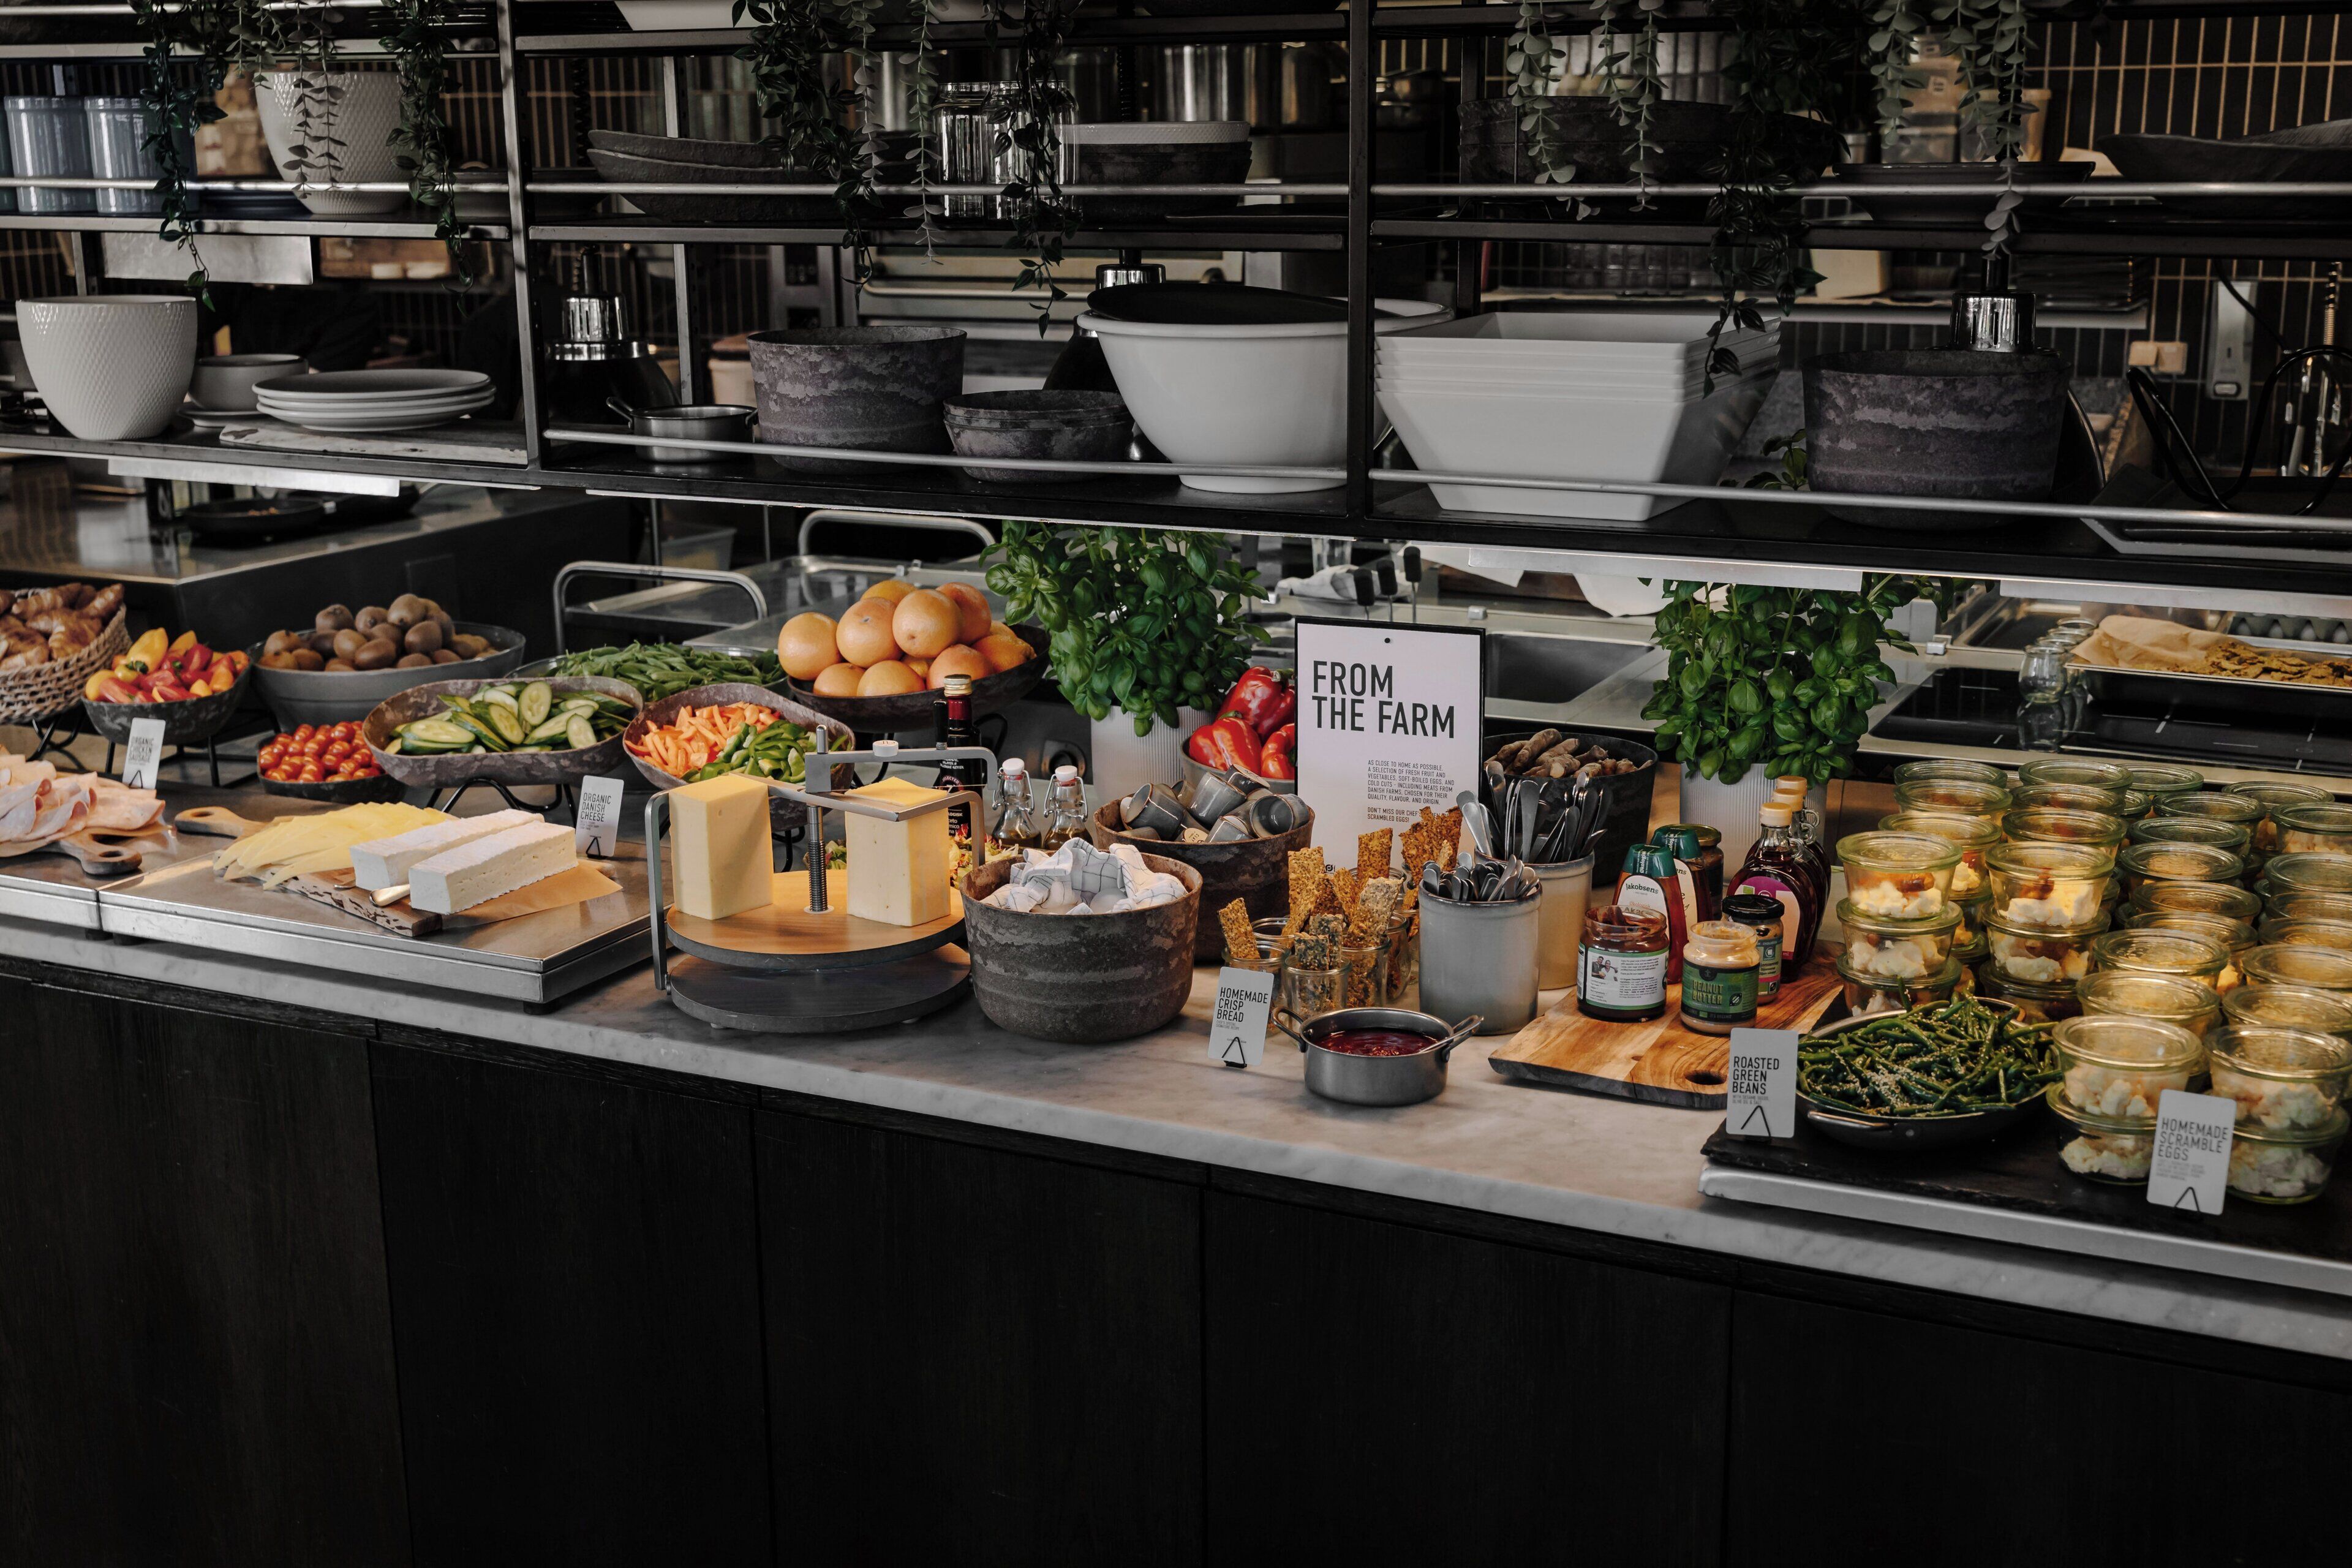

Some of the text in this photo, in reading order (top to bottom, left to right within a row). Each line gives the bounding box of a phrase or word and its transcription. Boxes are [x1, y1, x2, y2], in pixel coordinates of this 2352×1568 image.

[1314, 660, 1392, 698] FROM
[1312, 695, 1454, 738] THE FARM
[583, 793, 611, 804] ORGANIC
[582, 802, 605, 812] DANISH
[581, 811, 605, 822] CHEESE
[1626, 883, 1659, 894] Jakobsens
[1693, 980, 1724, 993] PEANUT
[1220, 987, 1268, 1004] HOMEMADE
[1692, 990, 1722, 1005] BUTTER
[1219, 998, 1243, 1011] CRISP
[1216, 1009, 1244, 1022] BREAD
[1733, 1056, 1779, 1070] ROASTED
[1733, 1069, 1767, 1082] GREEN
[1732, 1081, 1766, 1095] BEANS
[2162, 1117, 2228, 1140] HOMEMADE
[2160, 1131, 2223, 1153] SCRAMBLE
[2158, 1144, 2189, 1161] EGGS
